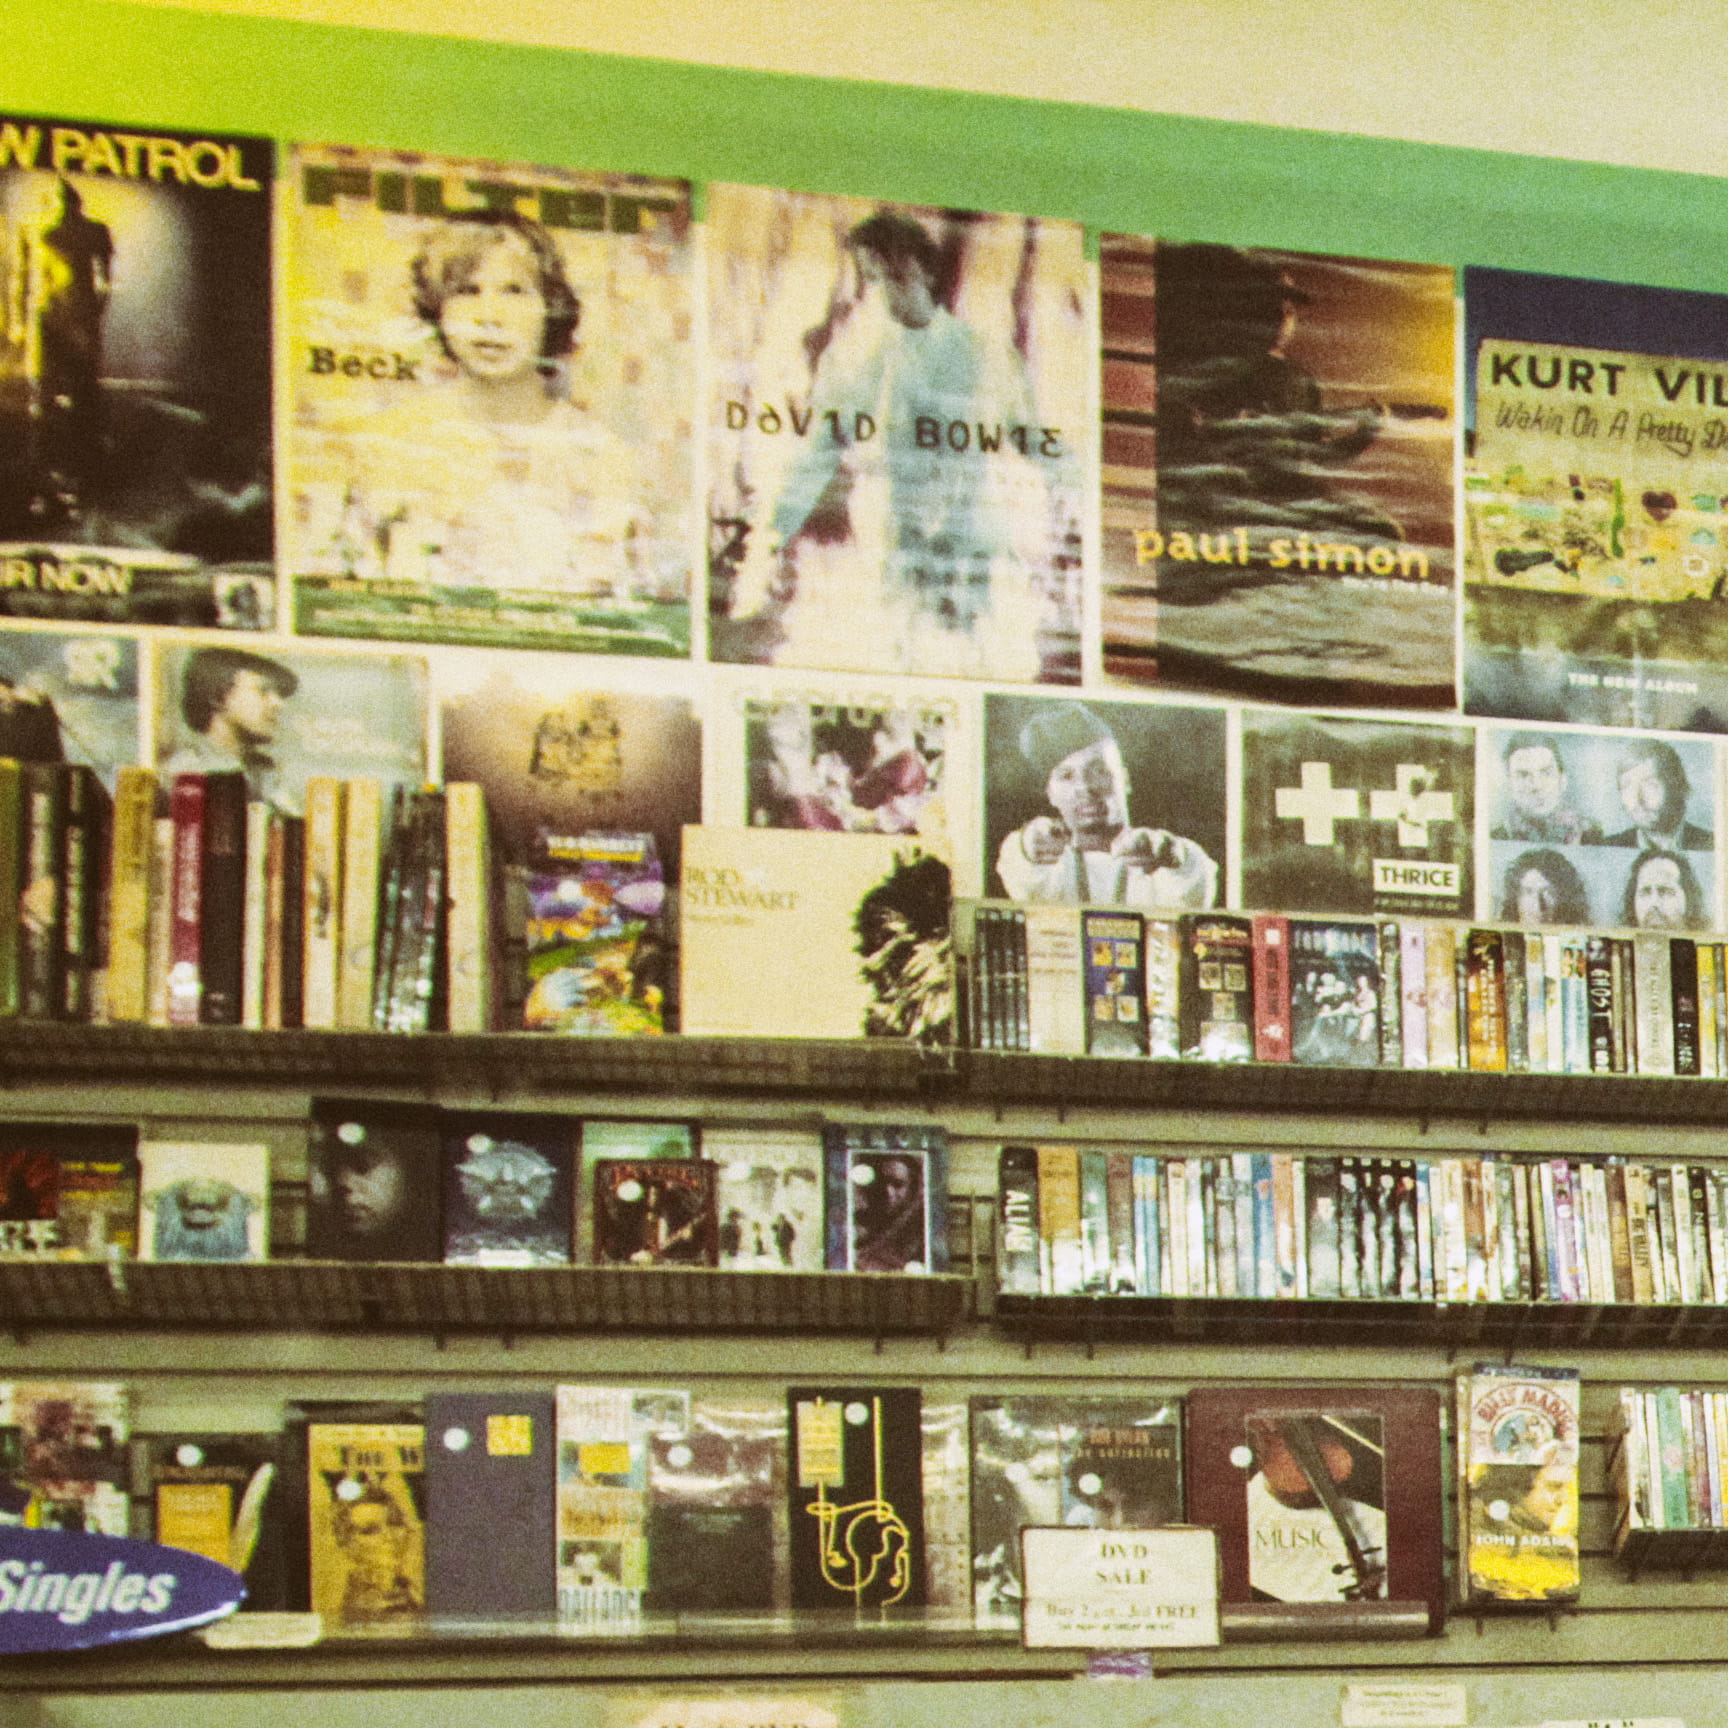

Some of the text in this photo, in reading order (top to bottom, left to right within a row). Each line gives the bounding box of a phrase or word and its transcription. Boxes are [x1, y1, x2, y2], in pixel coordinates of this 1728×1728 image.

[53, 134, 261, 191] PATROL
[308, 345, 422, 384] Beck
[1490, 350, 1626, 399] KURT
[1133, 525, 1429, 580] paul simon
[1379, 864, 1454, 889] THRICE
[1100, 1543, 1147, 1561] DVD
[1095, 1567, 1152, 1586] SALE
[1156, 1604, 1198, 1620] FREE
